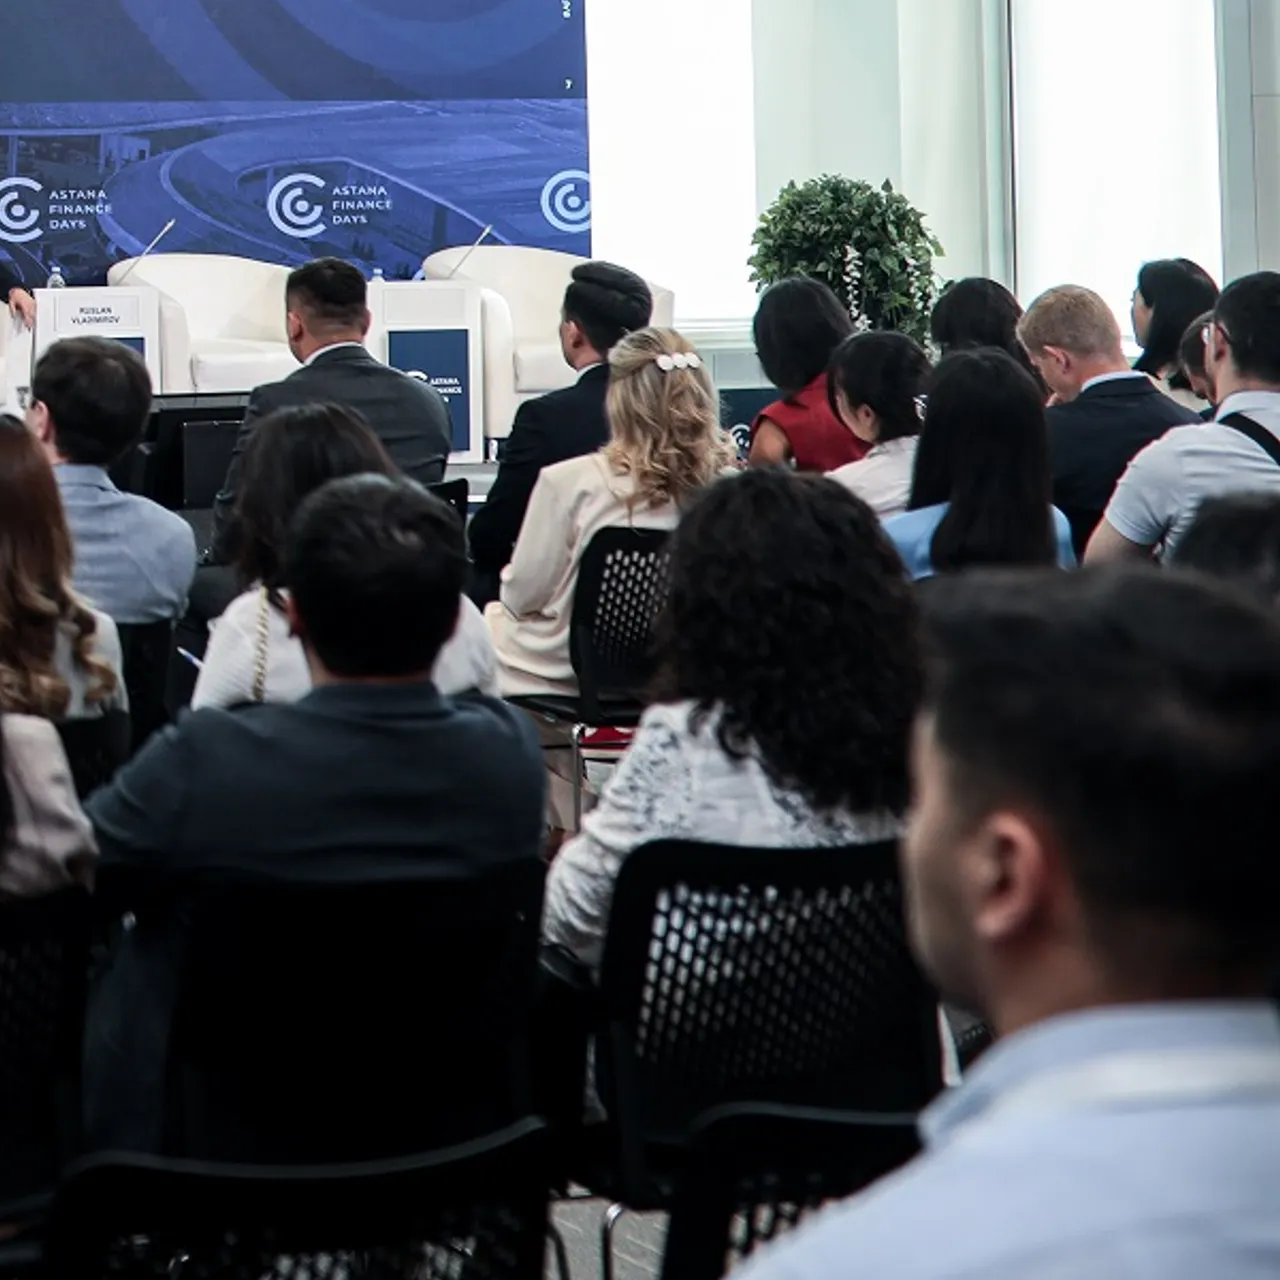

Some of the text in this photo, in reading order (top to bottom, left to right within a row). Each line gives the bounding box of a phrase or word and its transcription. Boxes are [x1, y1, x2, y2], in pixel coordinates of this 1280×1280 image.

[49, 189, 108, 200] ASTANA
[332, 186, 387, 196] ASTANA
[49, 204, 112, 215] FINANCE
[332, 200, 393, 211] FINANCE
[49, 220, 87, 230] DAYS
[332, 215, 368, 225] DAYS
